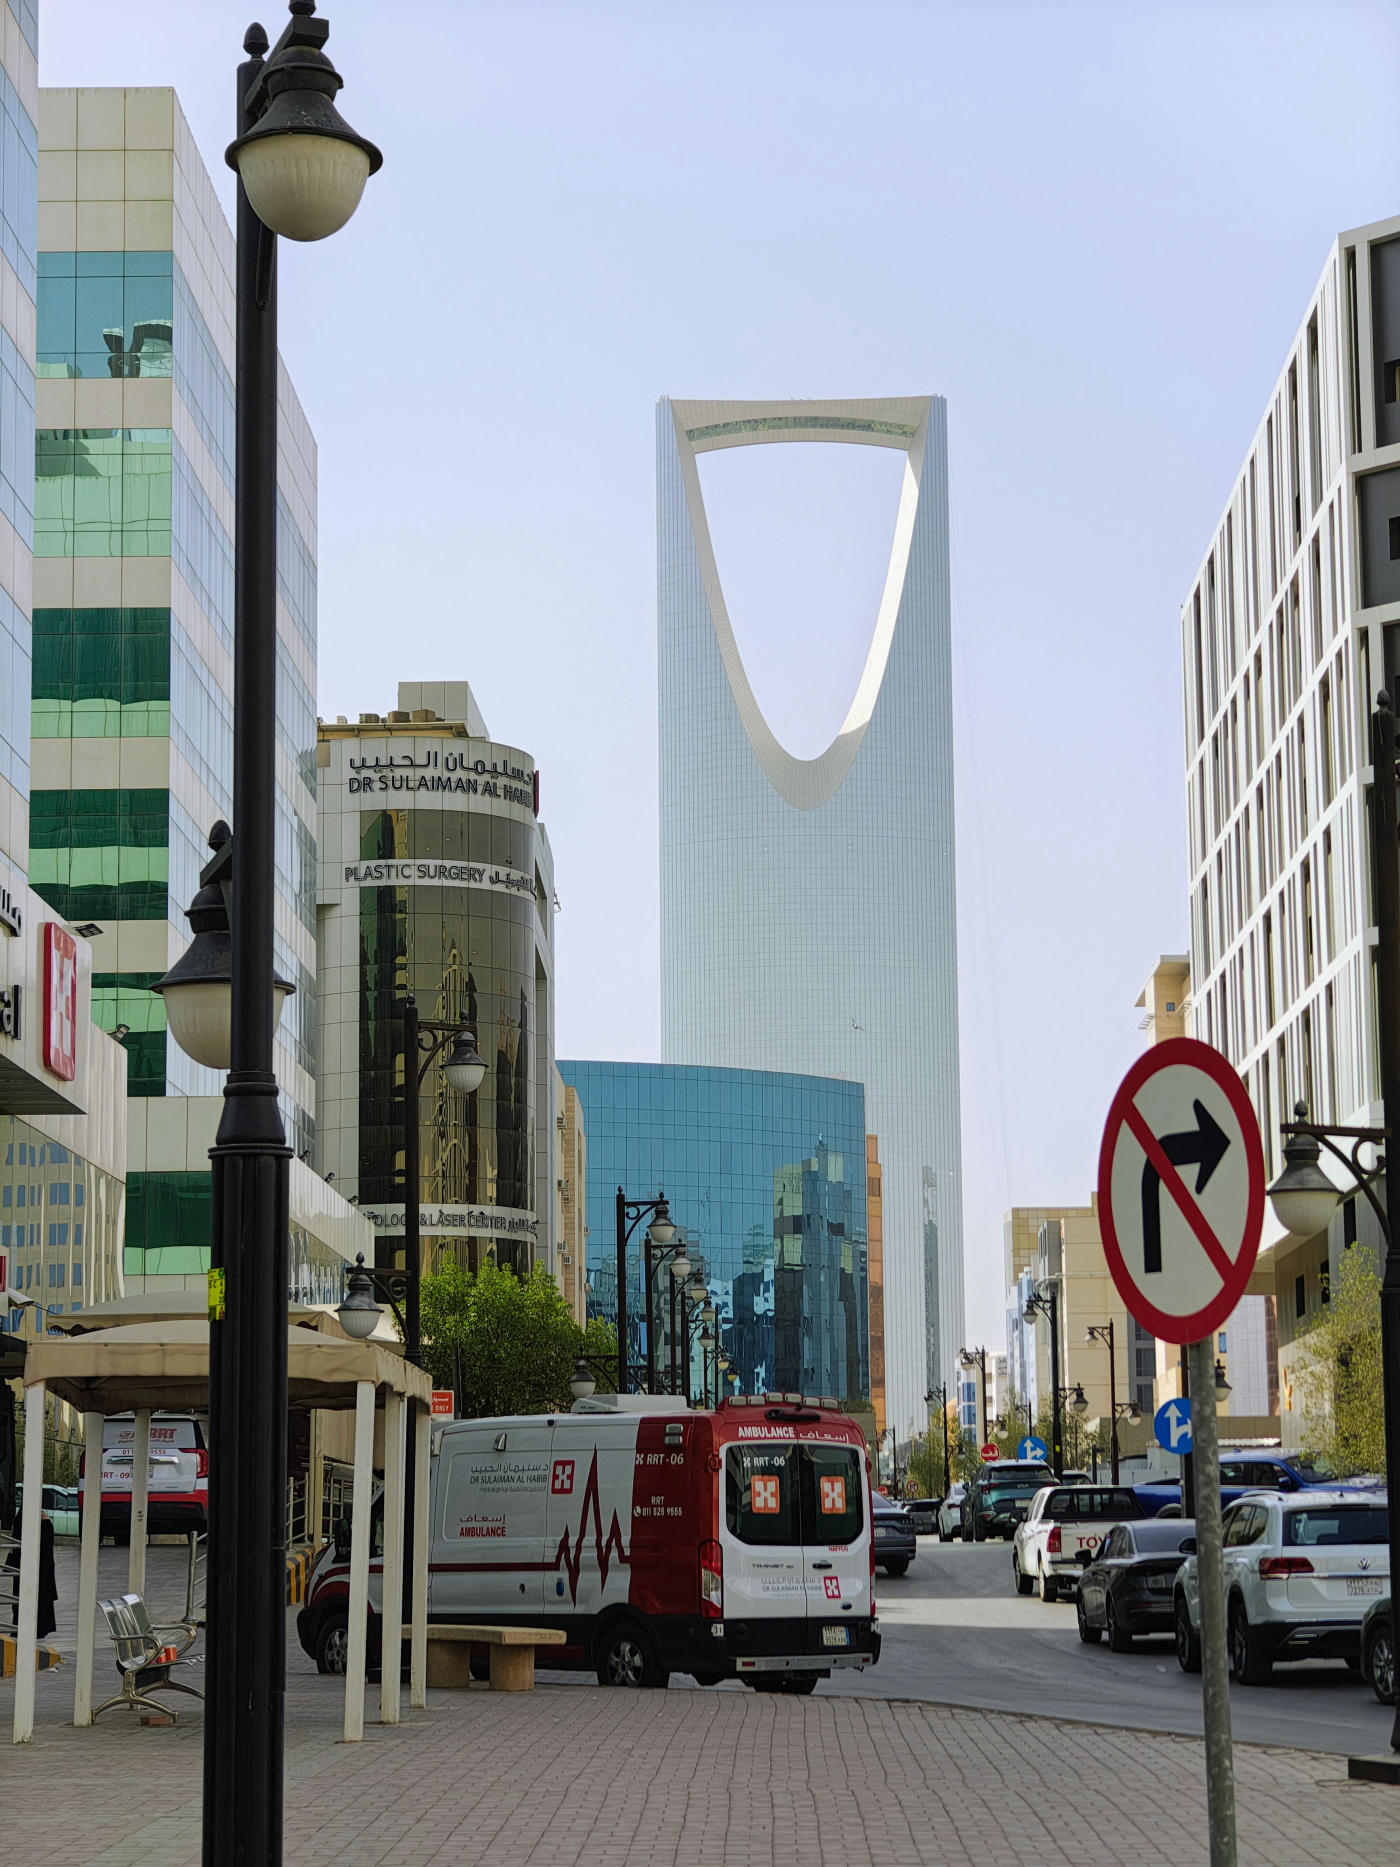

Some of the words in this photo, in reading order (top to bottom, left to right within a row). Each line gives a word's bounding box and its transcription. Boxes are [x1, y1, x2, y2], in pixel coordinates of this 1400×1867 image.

[350, 751, 438, 774] الحبيب
[349, 777, 374, 793] DR
[379, 775, 478, 794] SULAIMAN
[481, 780, 501, 799] AL
[503, 783, 532, 808] HABIB
[345, 864, 412, 882] PLASTIC
[417, 864, 486, 883] SURGERY
[420, 1215, 428, 1226] &
[430, 1213, 466, 1228] LASER
[468, 1213, 507, 1230] CENTER
[738, 1426, 795, 1438] AMBULANCE
[646, 1453, 664, 1465] RRT
[753, 1456, 769, 1466] RRT
[470, 1476, 480, 1484] DR
[480, 1475, 514, 1484] SULAIMAN
[516, 1474, 524, 1484] AL
[526, 1474, 548, 1483] HABIB
[651, 1496, 664, 1505] RRT
[642, 1507, 652, 1516] 011
[653, 1507, 665, 1516] 525
[666, 1506, 683, 1516] 9555
[460, 1514, 506, 1524] إسعاف
[460, 1526, 506, 1538] AMBULANCE
